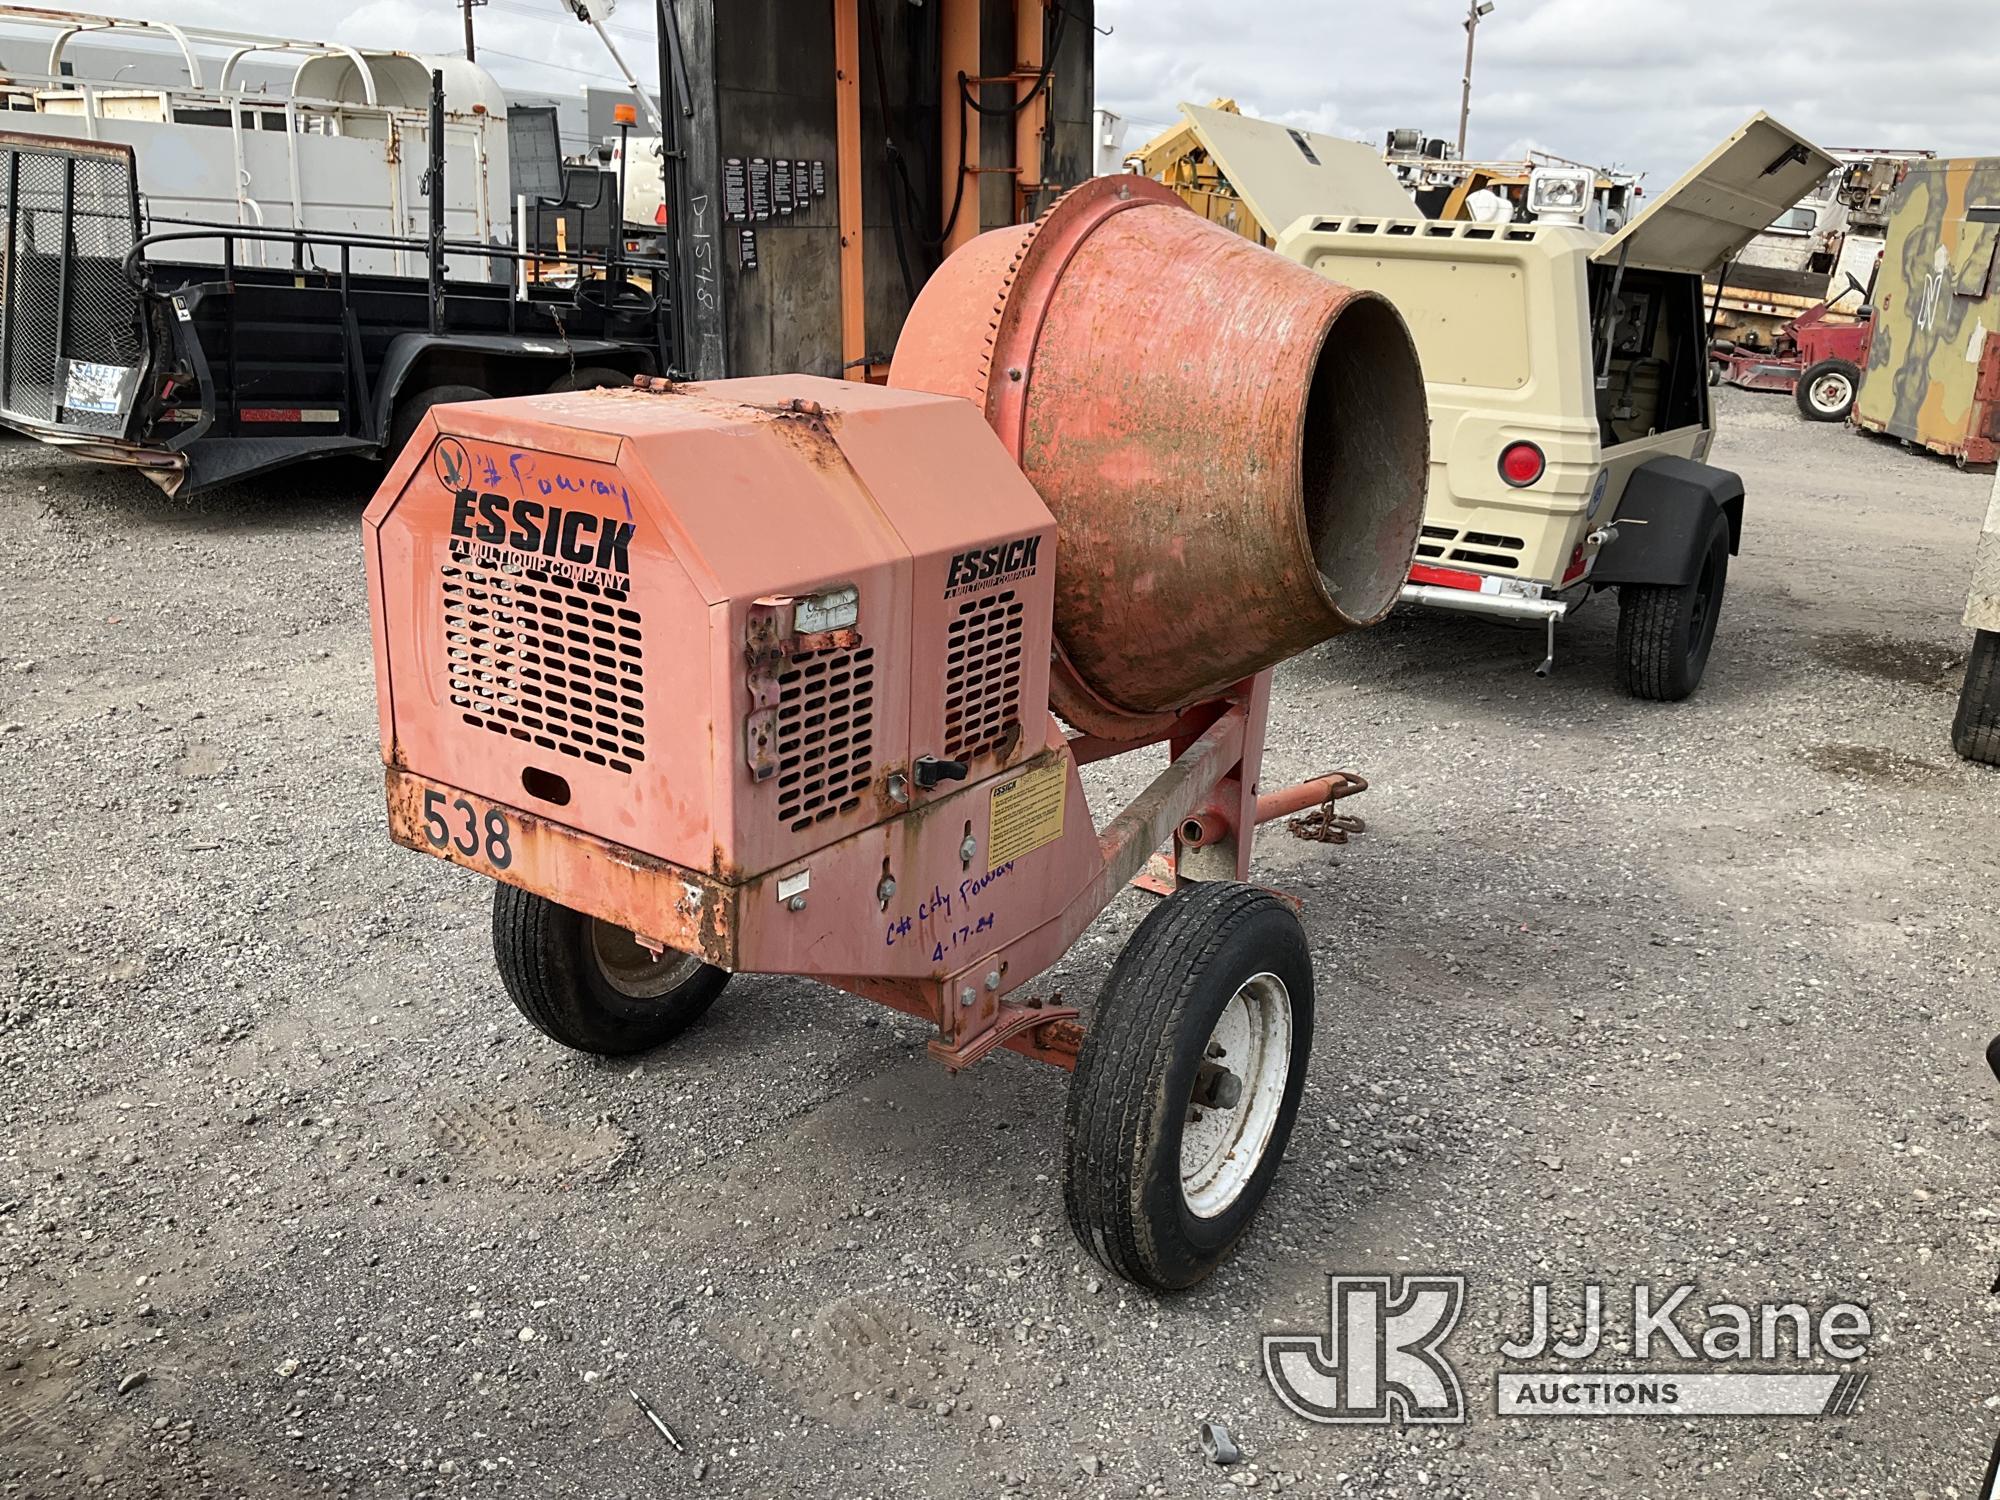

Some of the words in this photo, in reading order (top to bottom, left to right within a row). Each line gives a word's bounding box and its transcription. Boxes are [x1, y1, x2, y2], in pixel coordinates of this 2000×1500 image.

[451, 488, 637, 574] ESSICK
[456, 542, 465, 554] A
[468, 543, 547, 571] MULTIQUIP
[549, 562, 625, 590] COMPANY
[946, 535, 1042, 589] ESSICK
[993, 780, 1017, 797] ESSICK
[423, 788, 512, 869] 538
